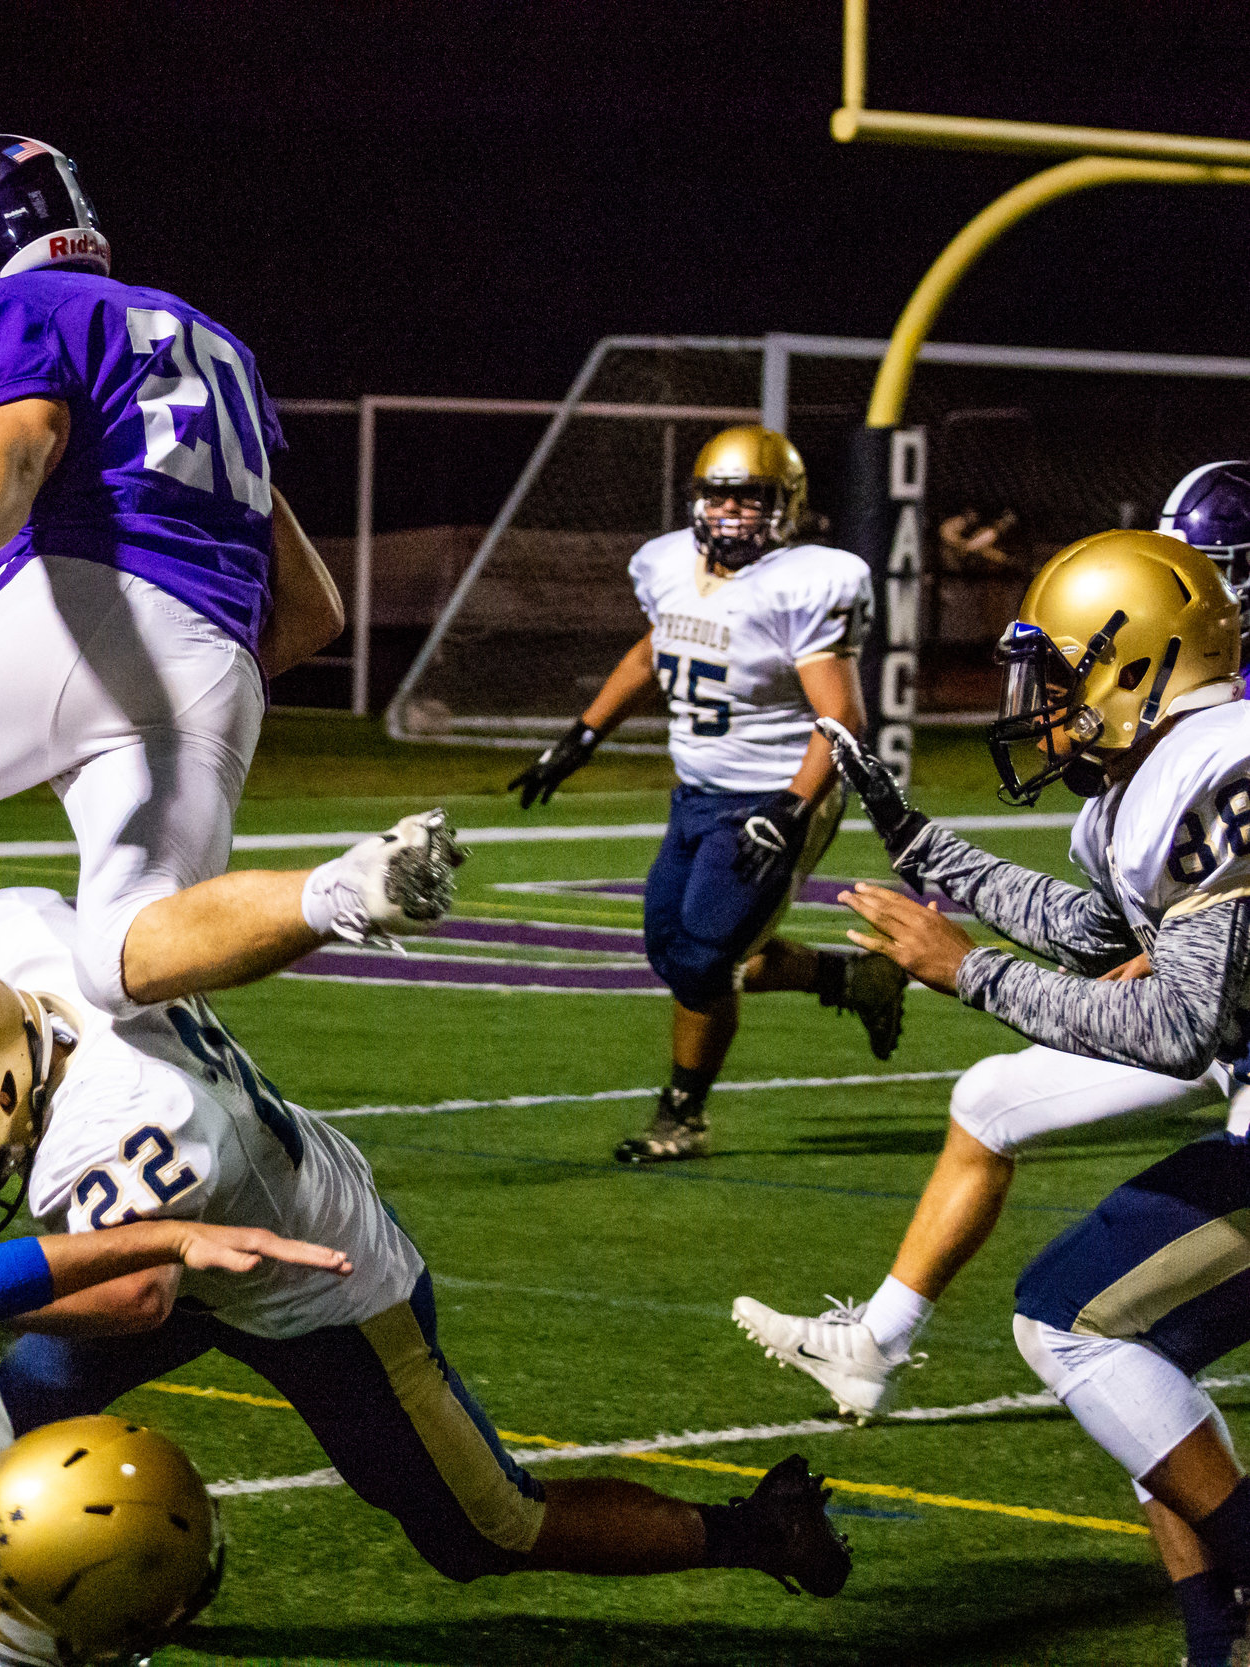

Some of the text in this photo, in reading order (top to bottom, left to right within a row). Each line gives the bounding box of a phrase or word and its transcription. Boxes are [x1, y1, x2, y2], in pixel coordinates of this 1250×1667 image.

[127, 307, 273, 517] 20
[657, 650, 731, 738] 75
[71, 1122, 204, 1231] 22
